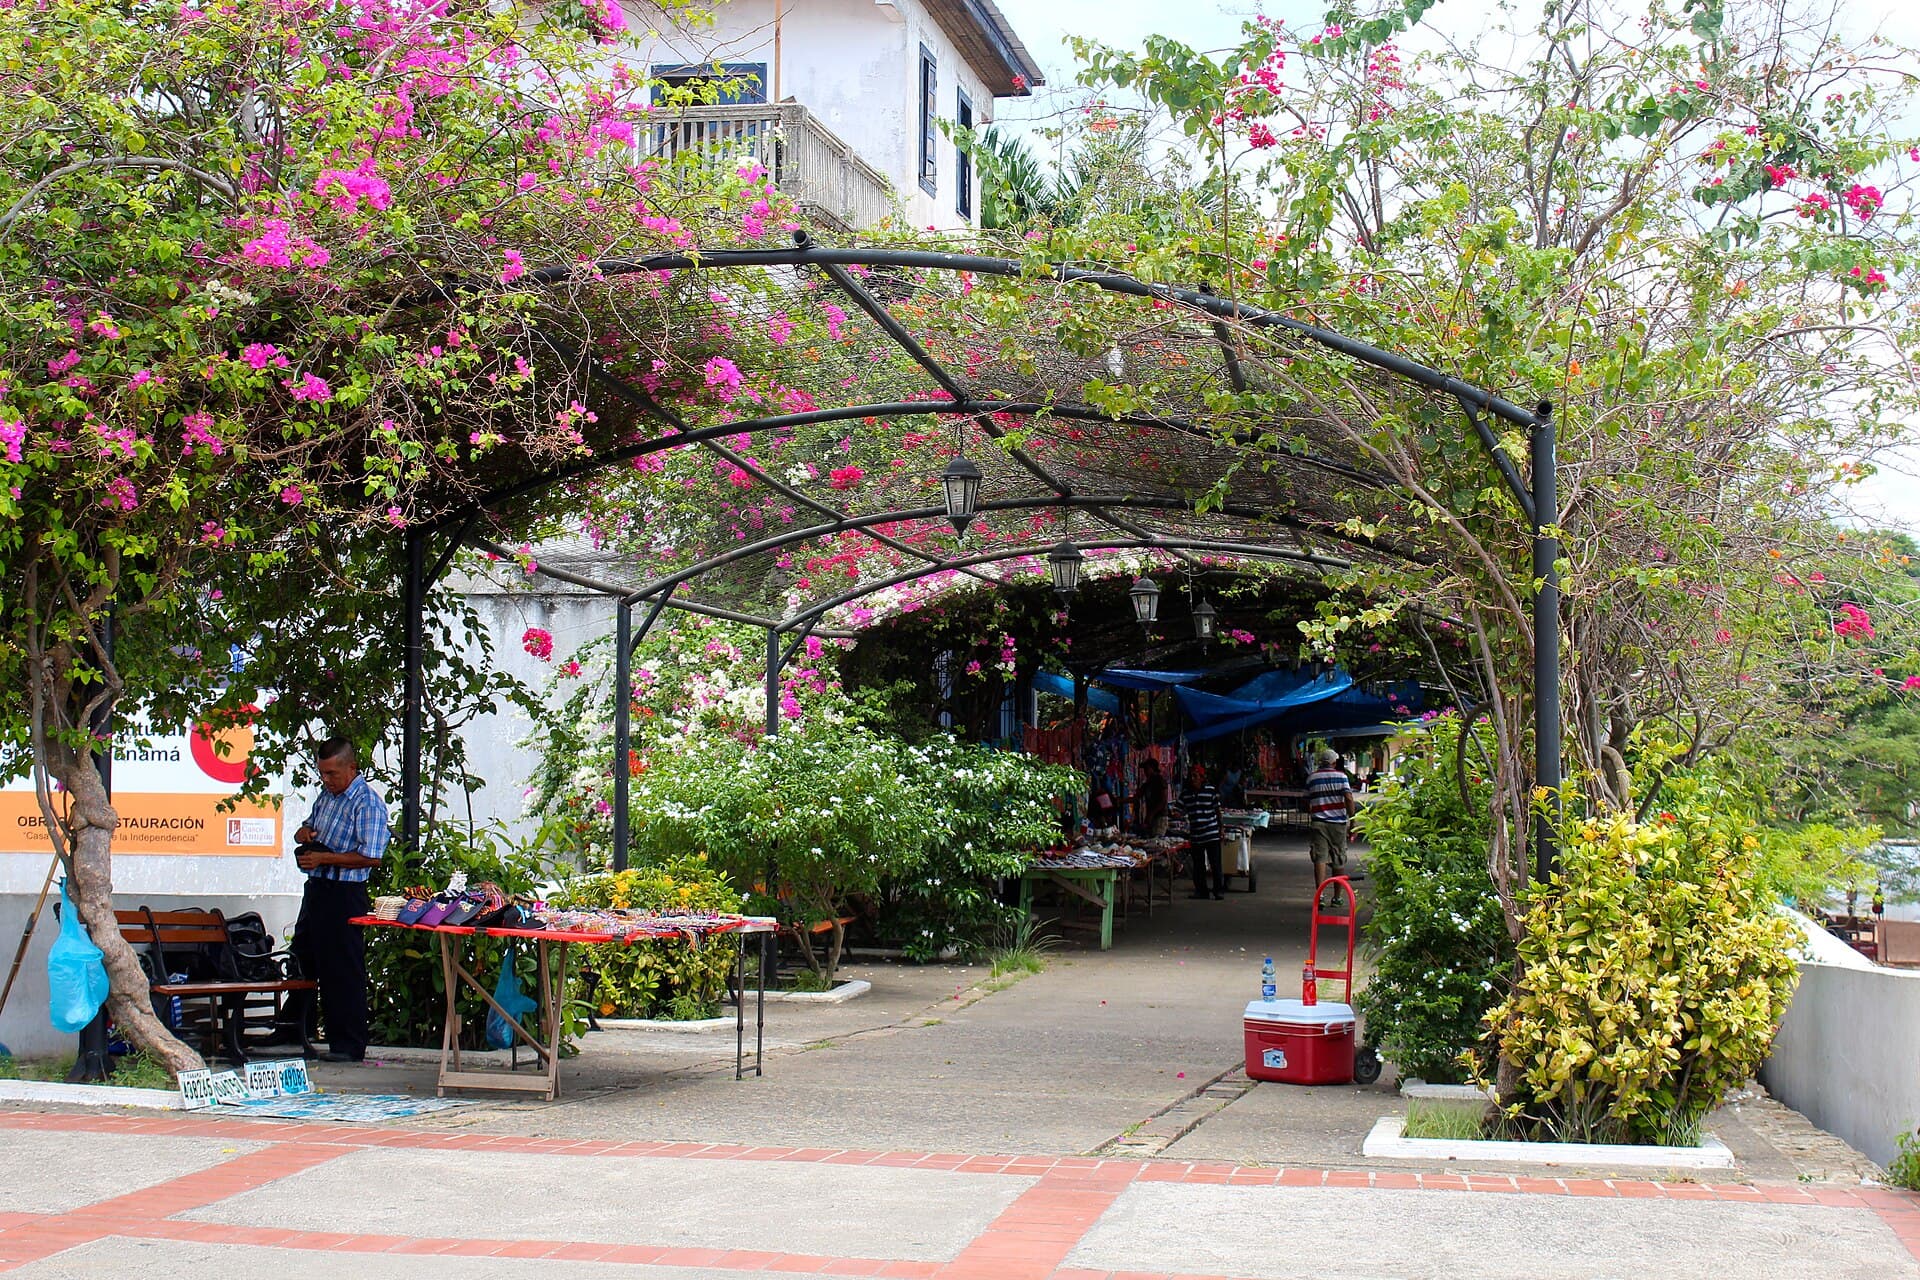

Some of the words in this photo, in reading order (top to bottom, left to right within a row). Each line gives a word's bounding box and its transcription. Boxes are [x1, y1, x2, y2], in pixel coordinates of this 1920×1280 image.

[114, 745, 181, 761] anamá
[115, 816, 204, 829] STAURACIÓN
[249, 1070, 277, 1091] 458058
